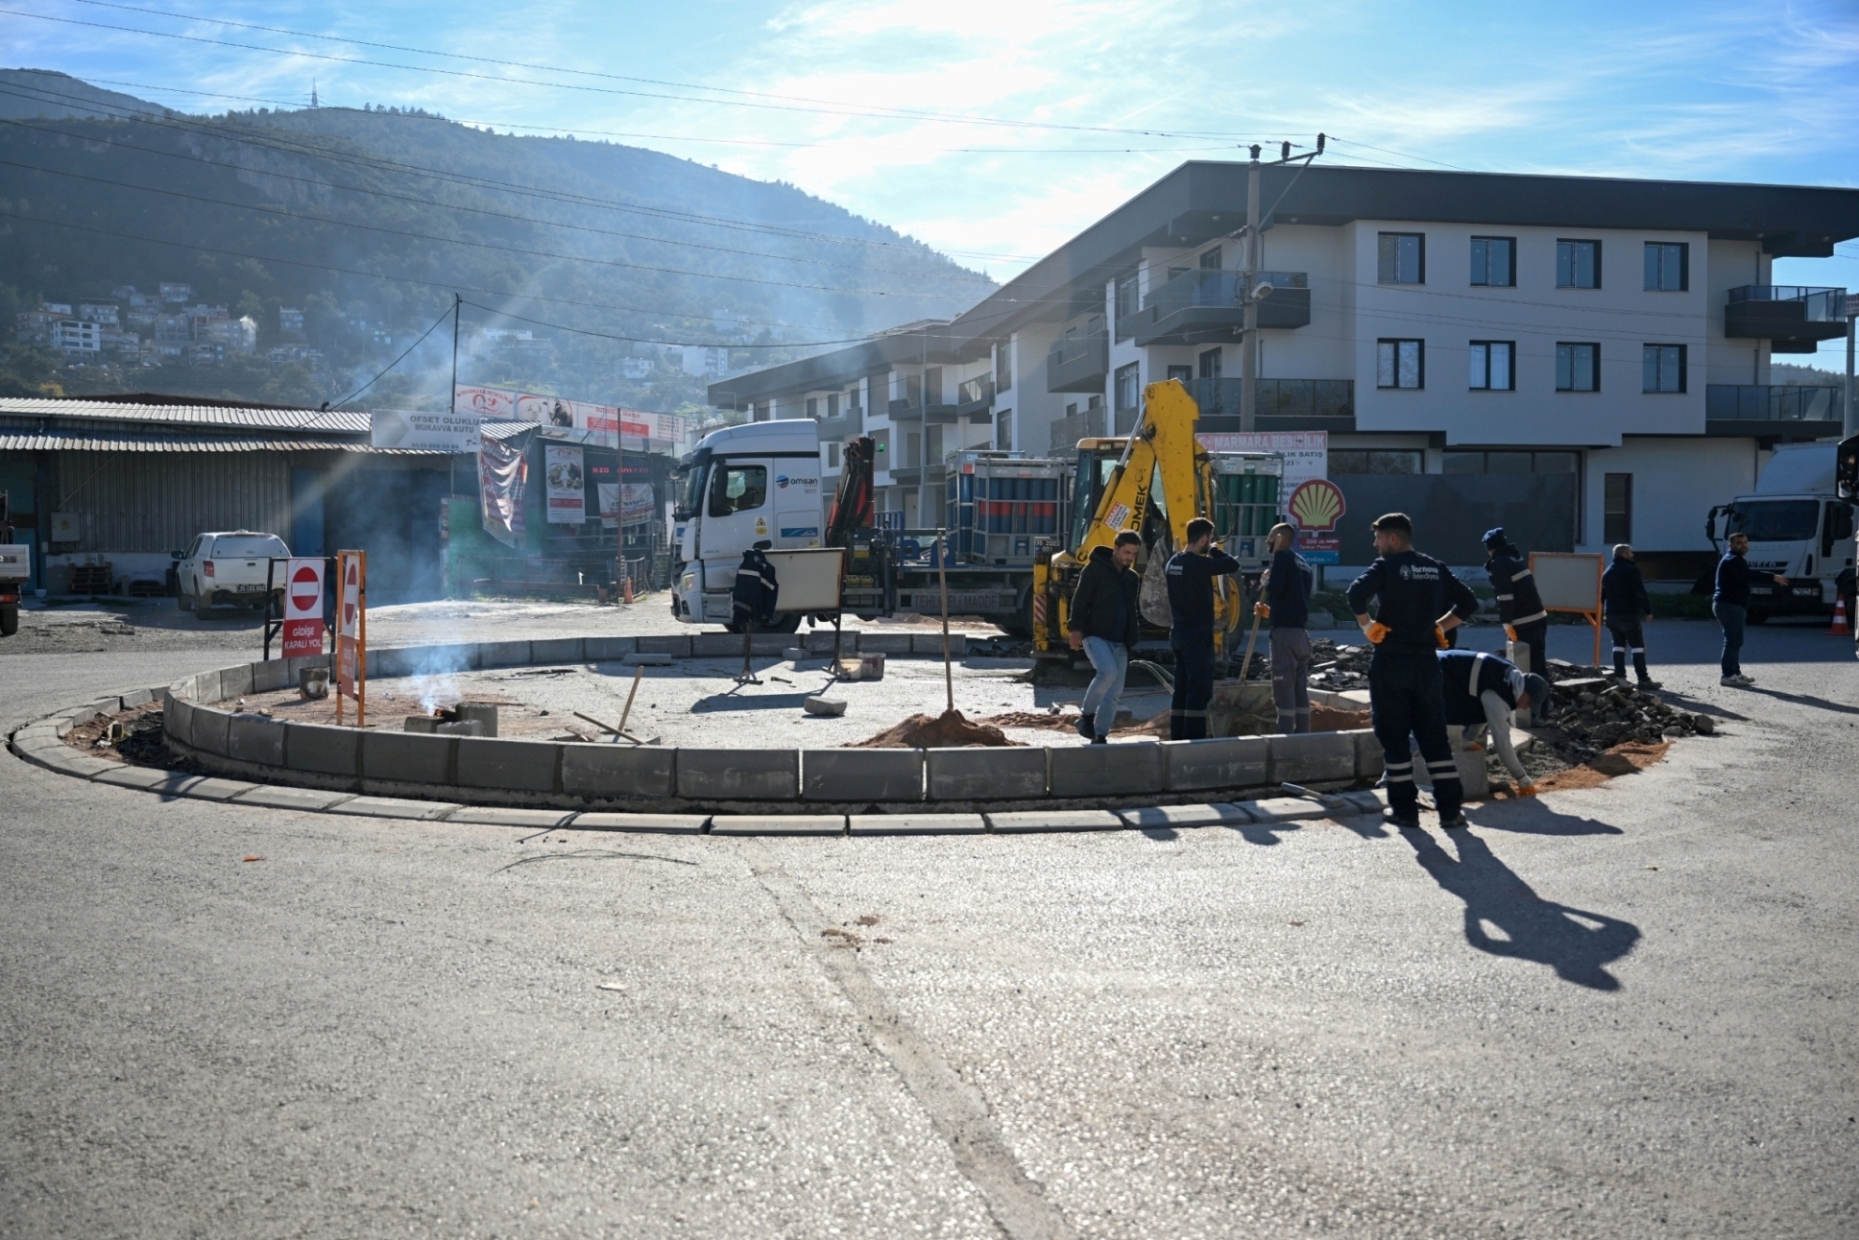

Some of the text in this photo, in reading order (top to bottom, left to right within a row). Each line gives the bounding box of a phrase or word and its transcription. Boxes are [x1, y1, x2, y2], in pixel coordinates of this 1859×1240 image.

[410, 415, 479, 426] OFSET OLUKLU
[415, 423, 452, 432] MUKAVVA
[1214, 435, 1269, 449] MARMARA
[1130, 485, 1147, 532] OMEK
[914, 595, 997, 609] TEHLİELİ MADDE
[292, 626, 315, 637] GİDİŞE
[284, 639, 322, 649] KAPALI YOL
